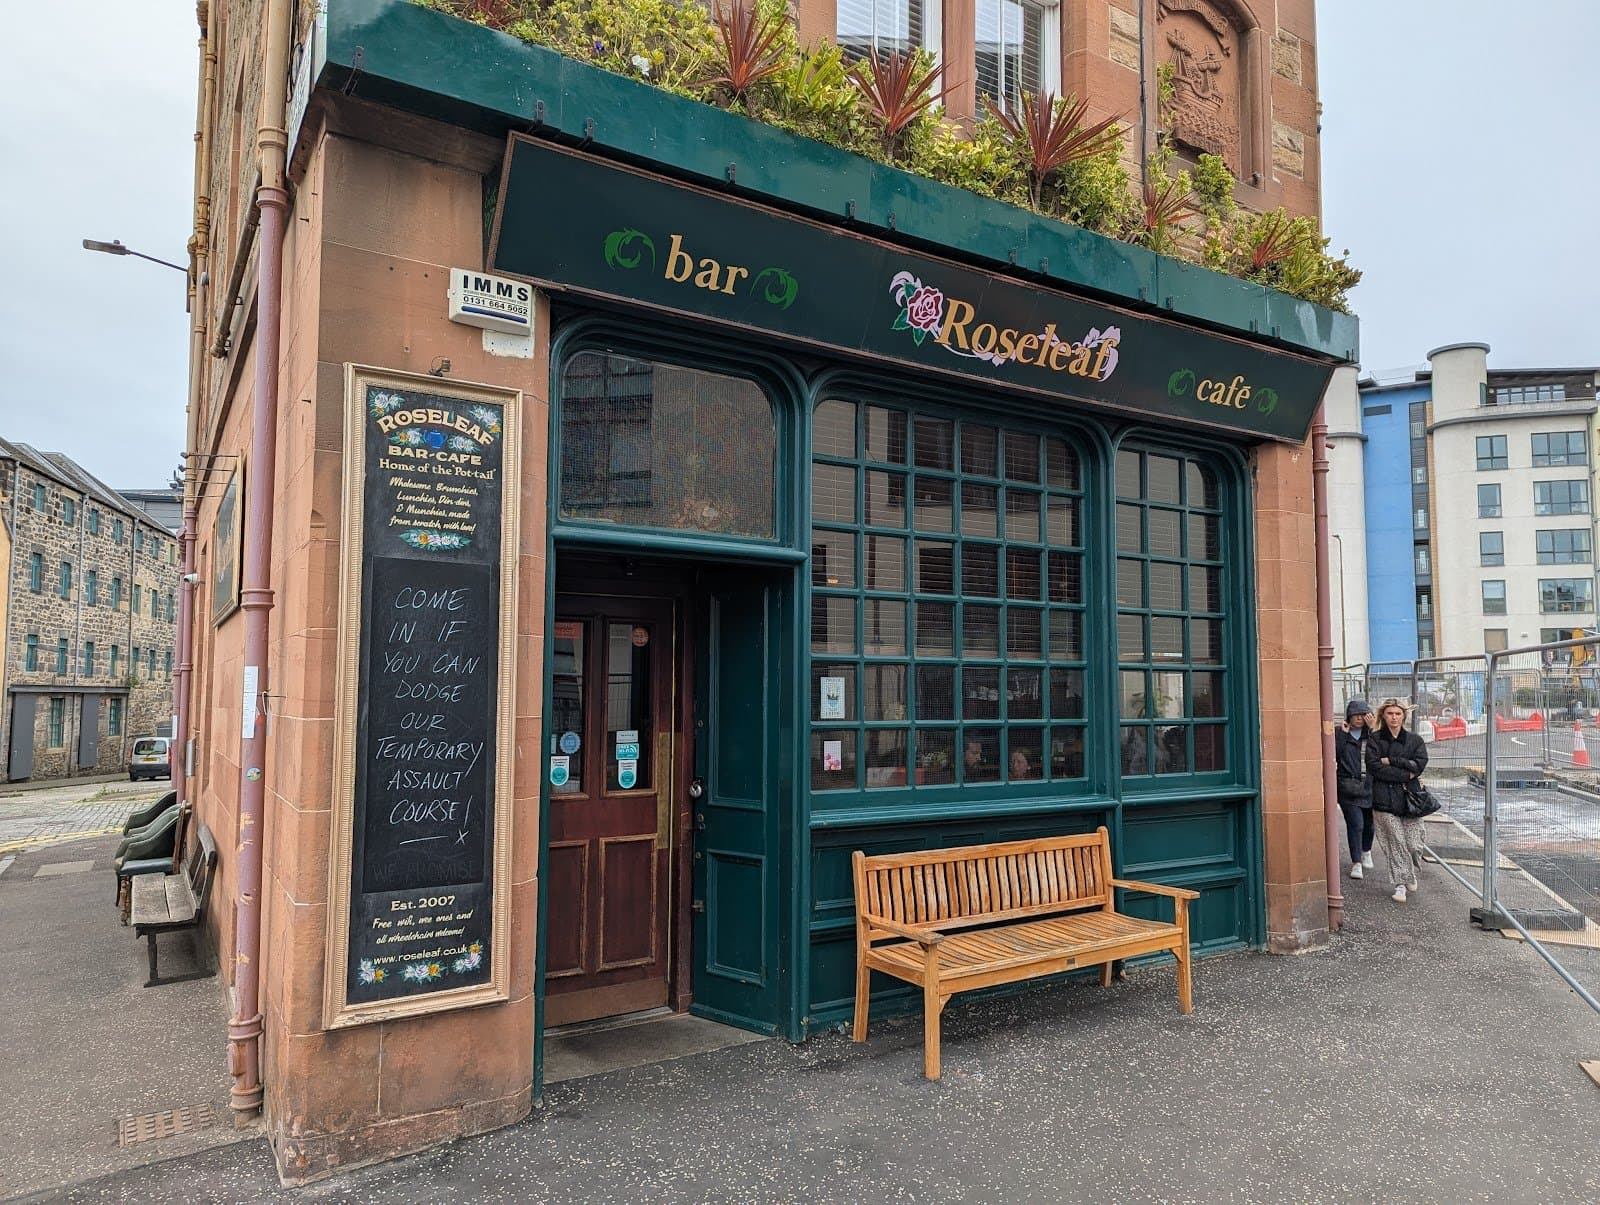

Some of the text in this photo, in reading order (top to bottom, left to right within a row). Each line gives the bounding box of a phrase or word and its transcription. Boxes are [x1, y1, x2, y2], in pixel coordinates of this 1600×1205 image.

[664, 234, 748, 295] bar
[463, 275, 529, 302] IMMS
[463, 296, 485, 305] 0131
[489, 300, 505, 309] 664
[507, 305, 528, 315] 5052
[934, 298, 1118, 379] Roseleaf
[376, 408, 494, 446] ROSELEAF
[379, 458, 415, 472] Home
[417, 463, 430, 473] of
[432, 464, 452, 476] the
[389, 477, 431, 490] Wholesome
[389, 515, 411, 526] from
[443, 522, 460, 530] with
[448, 510, 470, 519] made
[395, 587, 471, 611] COME
[388, 620, 467, 643] IN IF
[384, 651, 480, 674] YOU CAN
[395, 680, 467, 702] DODGE
[400, 712, 447, 731] OUR
[375, 736, 484, 777] TEMPORARY
[386, 769, 464, 790] ASSAULT
[390, 895, 456, 912] Est. 2007
[372, 917, 392, 930] Free
[418, 917, 433, 925] wee
[435, 913, 453, 923] ones
[456, 909, 473, 921] and
[376, 935, 387, 945] all
[387, 930, 434, 943] wheelchairs
[373, 944, 468, 965] www.roseleaf.co.uk
